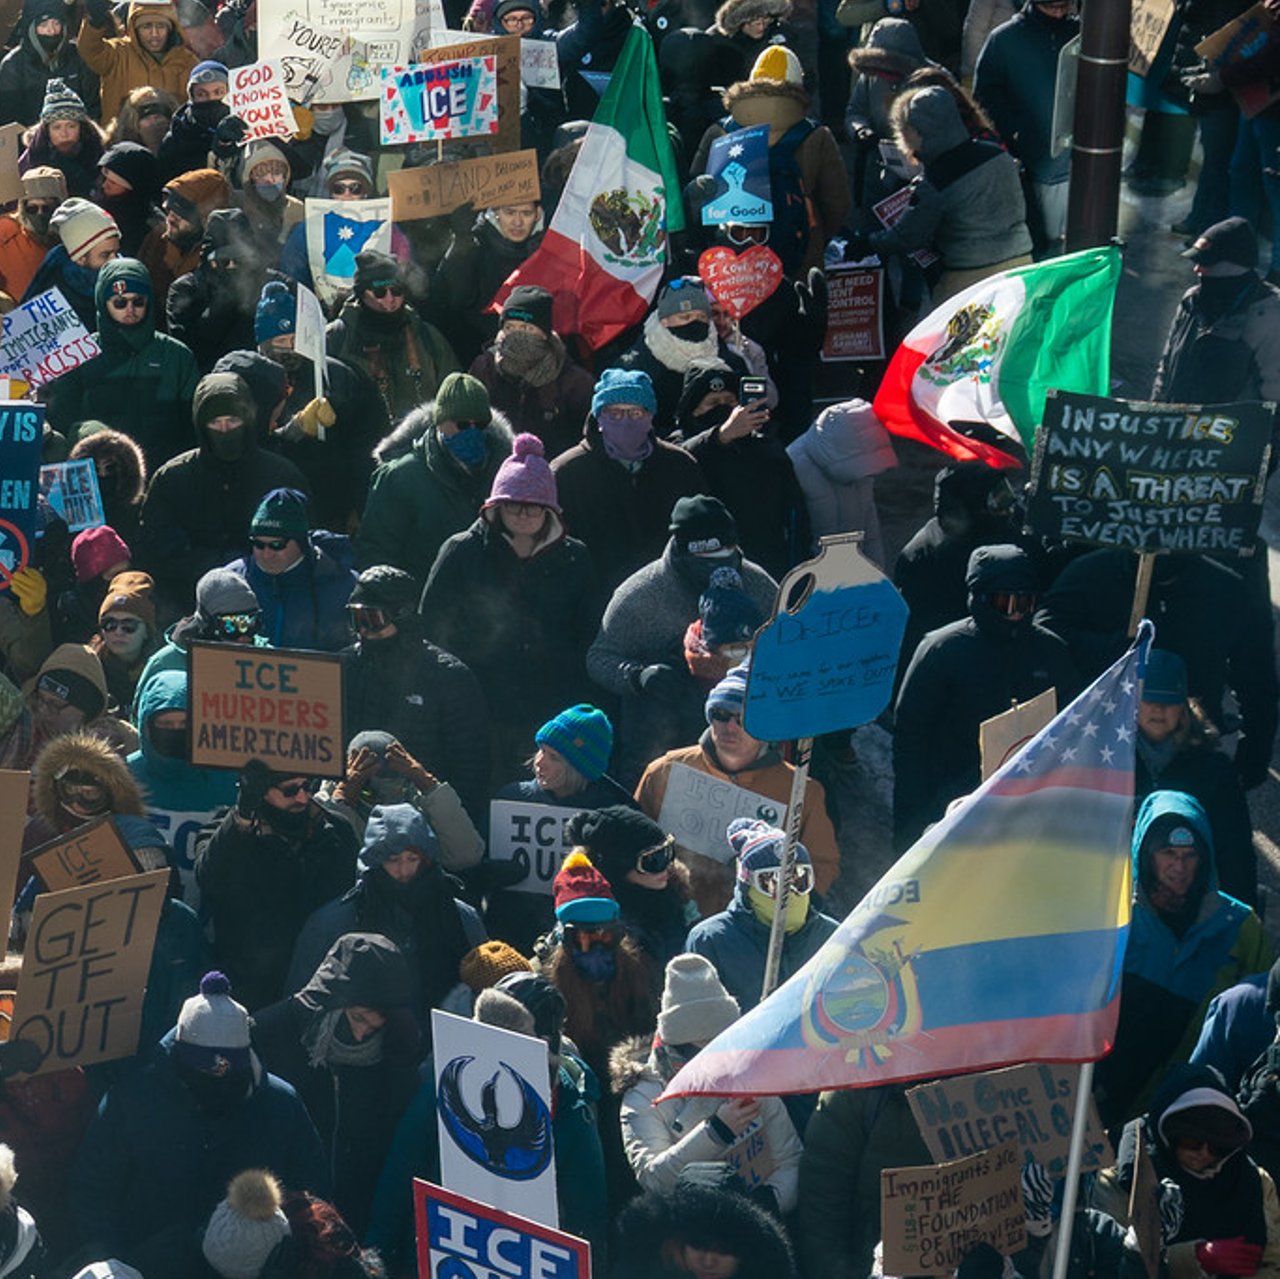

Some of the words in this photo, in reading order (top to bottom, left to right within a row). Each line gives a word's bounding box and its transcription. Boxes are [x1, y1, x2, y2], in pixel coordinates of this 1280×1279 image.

[236, 66, 273, 88] GOD
[400, 62, 472, 87] ABOLISH
[232, 85, 281, 109] KNOWS
[240, 102, 283, 123] YOUR
[422, 82, 465, 121] ICE
[12, 412, 37, 441] IS
[1060, 408, 1233, 442] INJUSTICE
[1052, 470, 1083, 492] IS
[1091, 471, 1114, 496] A
[1131, 476, 1249, 503] THREAT
[1054, 496, 1092, 517] TO
[1107, 498, 1222, 521] JUSTICE
[235, 660, 299, 694] ICE
[201, 692, 329, 730] MURDERS
[197, 722, 334, 763] AMERICANS
[37, 886, 154, 964] GET
[37, 967, 112, 1011] TF
[21, 996, 126, 1067] OUT
